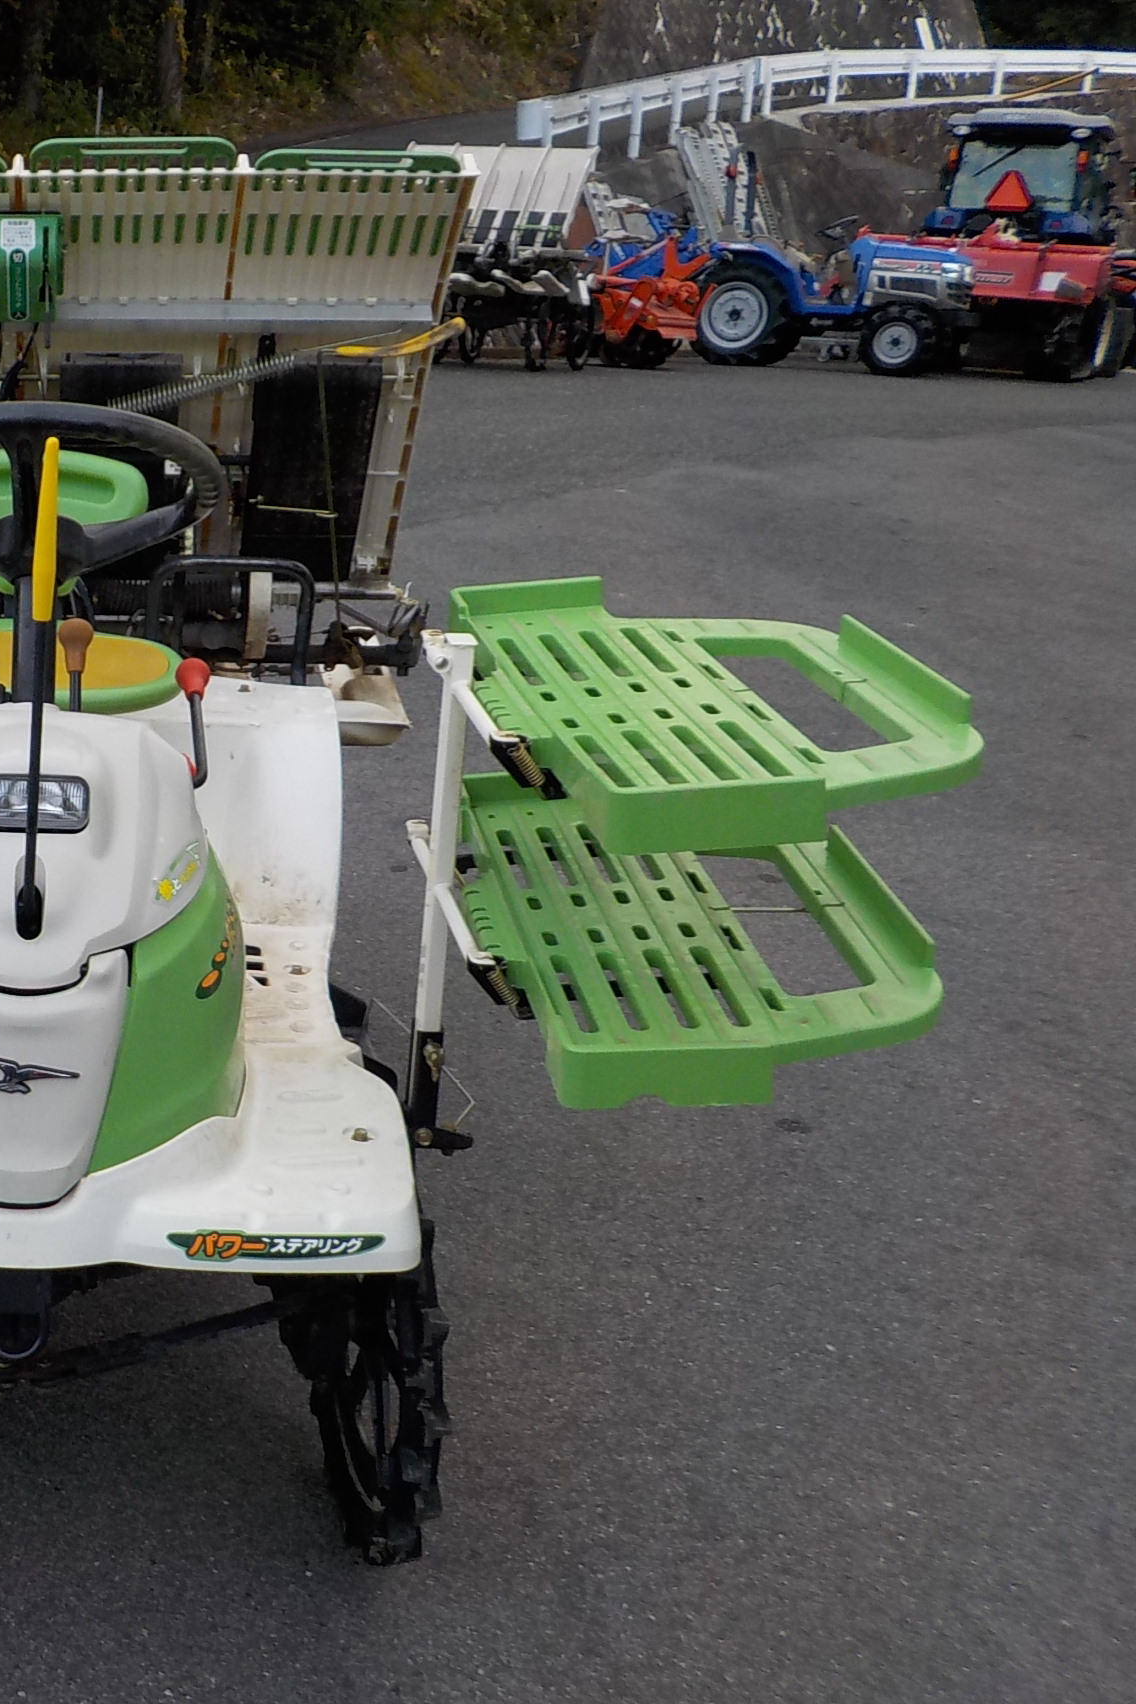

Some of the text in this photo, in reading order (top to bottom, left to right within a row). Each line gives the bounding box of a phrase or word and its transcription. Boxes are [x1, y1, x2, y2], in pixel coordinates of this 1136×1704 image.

[188, 1231, 365, 1258] パワーステアリング
